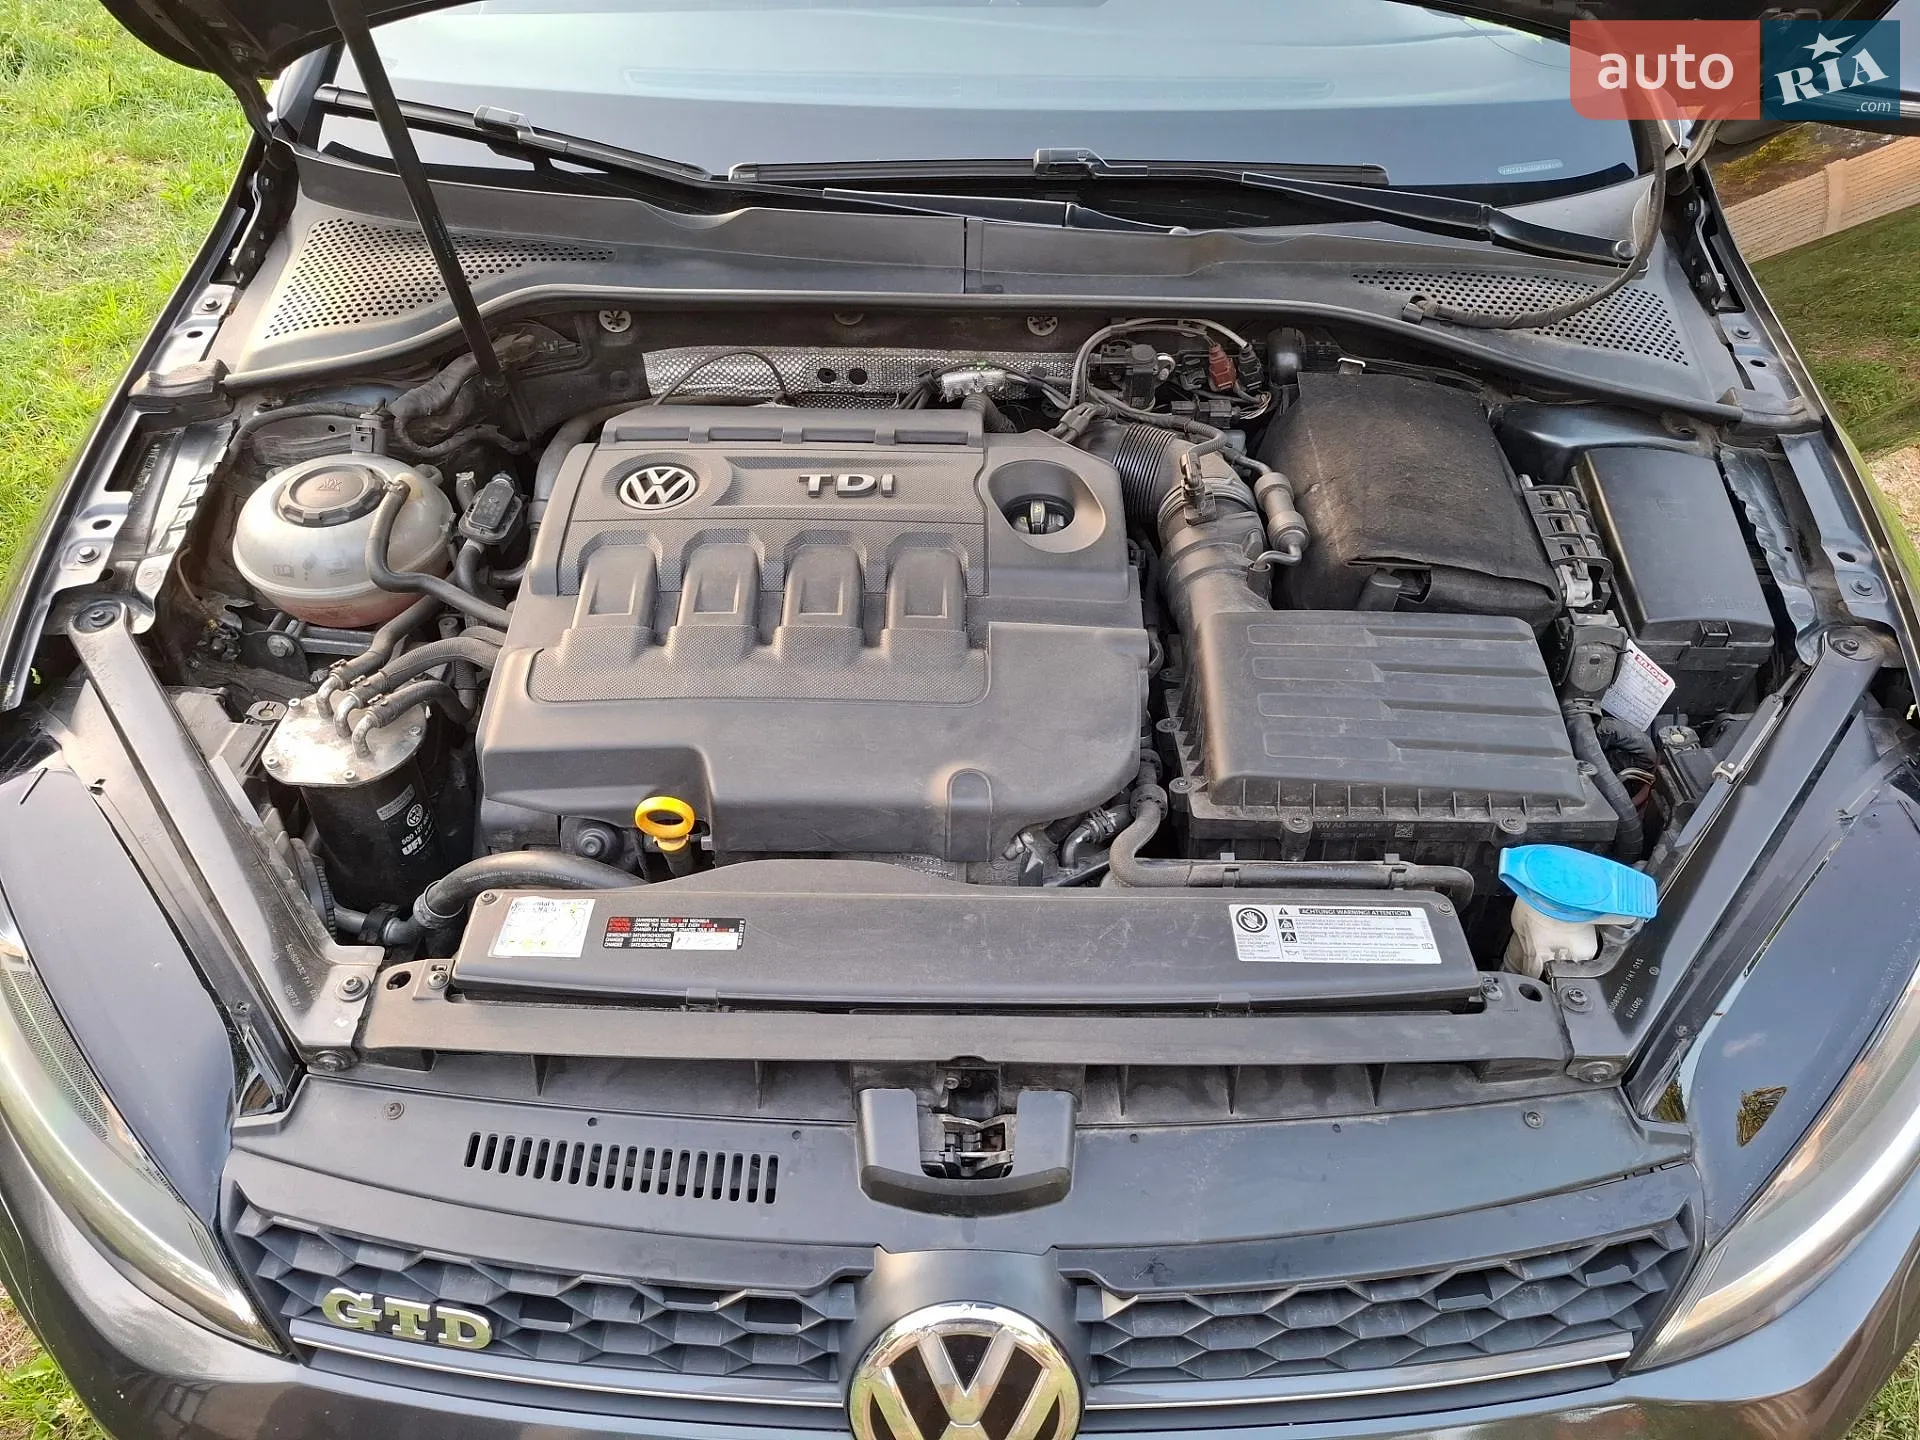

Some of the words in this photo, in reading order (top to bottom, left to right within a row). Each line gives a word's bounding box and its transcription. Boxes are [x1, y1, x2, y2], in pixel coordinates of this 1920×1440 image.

[799, 474, 897, 498] TDI
[1635, 654, 1668, 685] MOTUL
[1371, 909, 1410, 917] ATTENTION!
[321, 1287, 493, 1350] GTD
